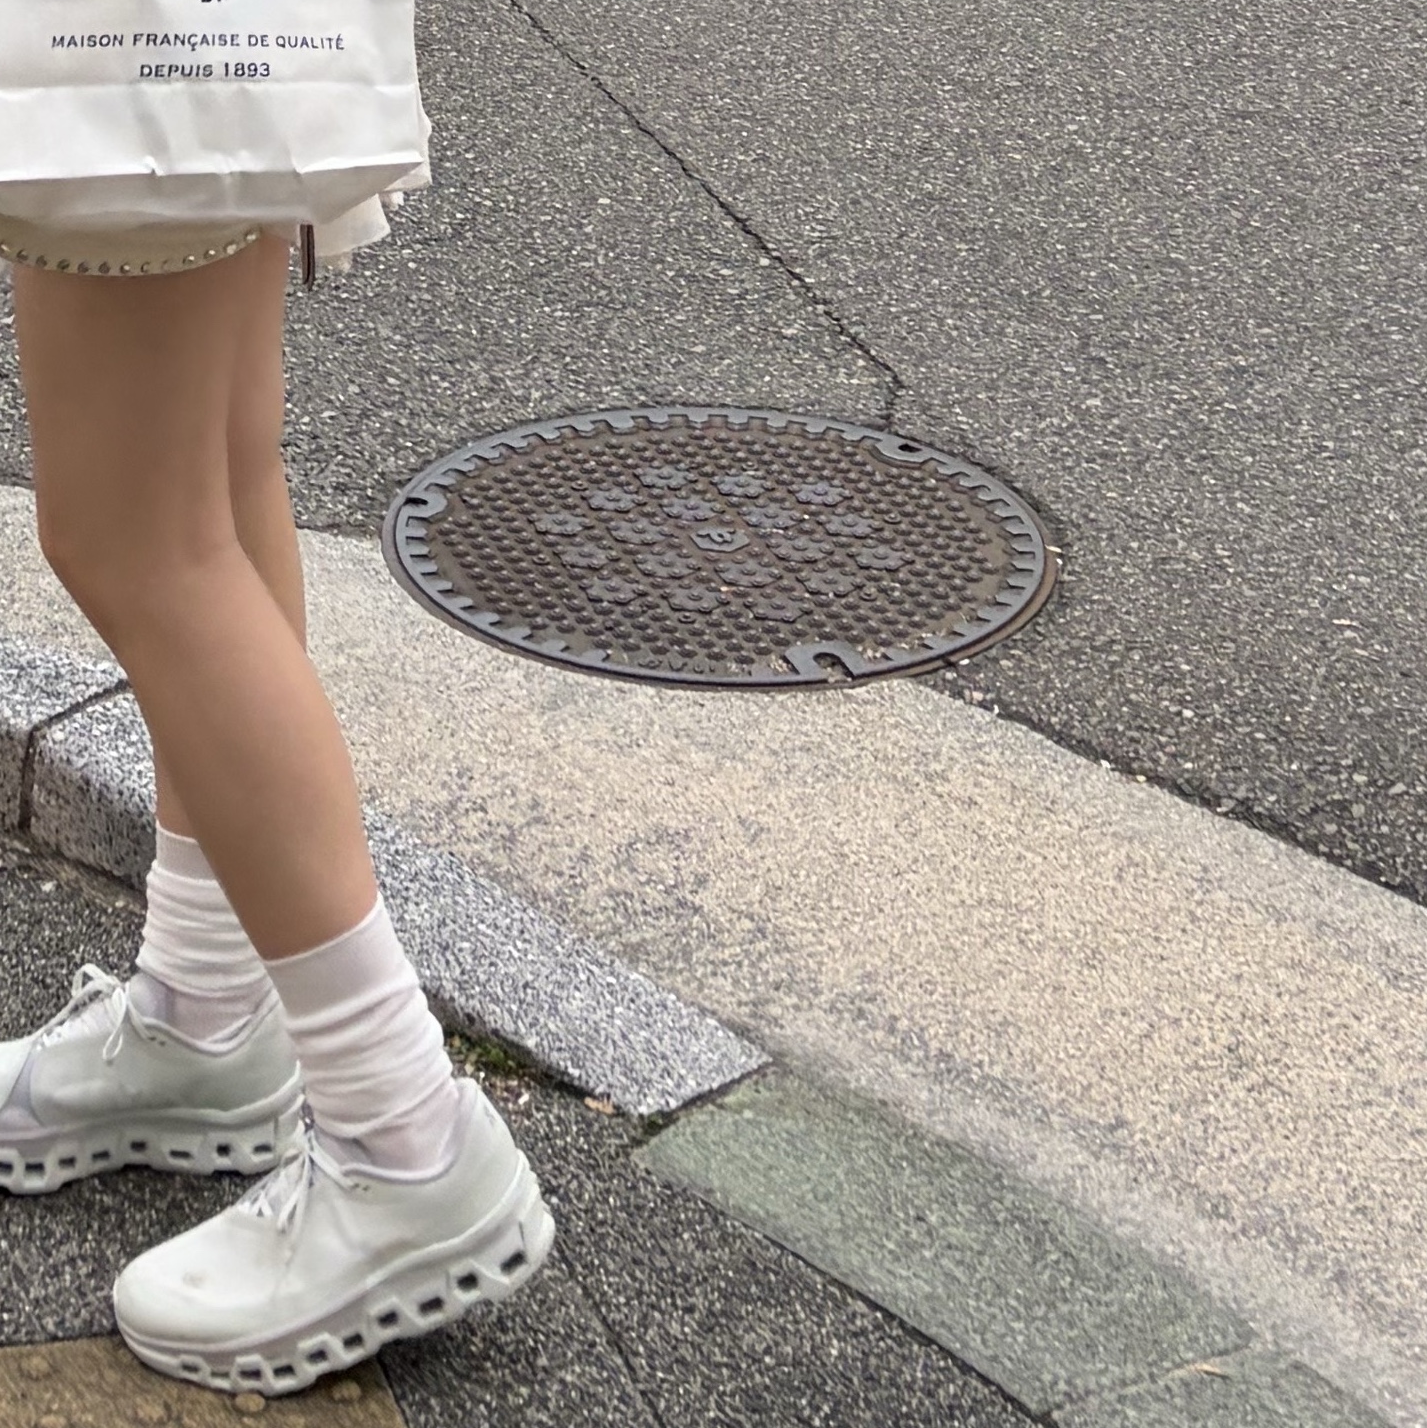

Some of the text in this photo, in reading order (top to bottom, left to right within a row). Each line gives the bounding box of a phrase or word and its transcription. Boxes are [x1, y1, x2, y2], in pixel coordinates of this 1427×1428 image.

[52, 32, 346, 52] MAISON FRANÇAISE DE QUALITÉ
[139, 62, 271, 78] DEPUIS 1893
